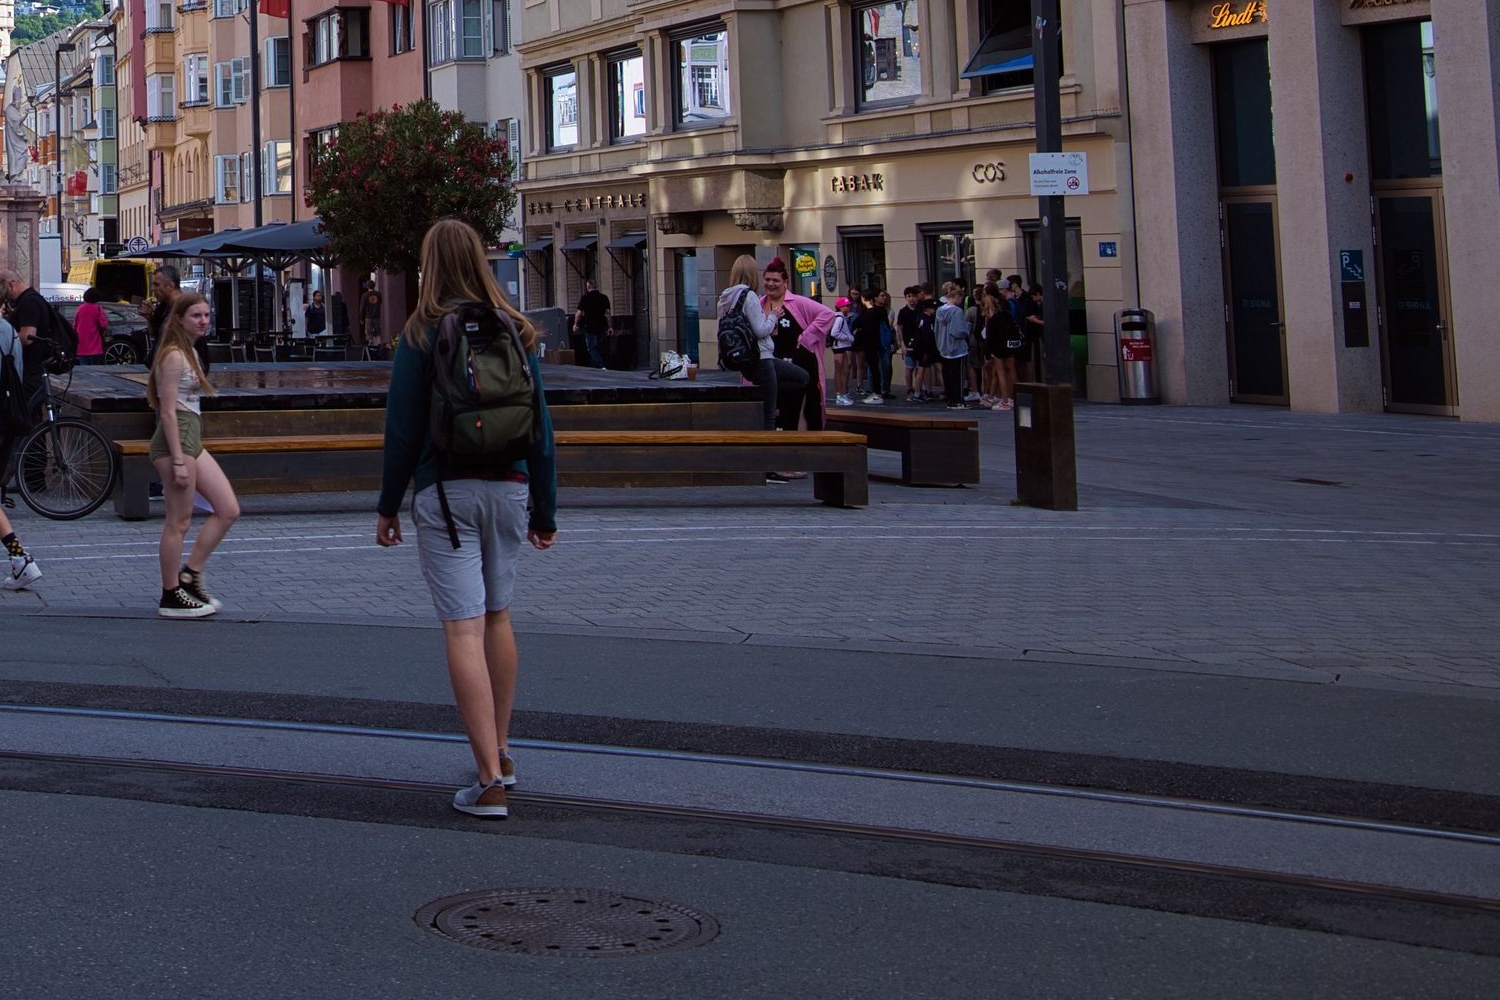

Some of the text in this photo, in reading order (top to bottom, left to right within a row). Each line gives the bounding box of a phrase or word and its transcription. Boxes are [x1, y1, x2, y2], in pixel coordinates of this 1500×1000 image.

[1209, 1, 1258, 29] Lindt
[831, 172, 884, 192] TABAK
[972, 161, 1007, 184] COS
[563, 192, 647, 213] CENTRALE
